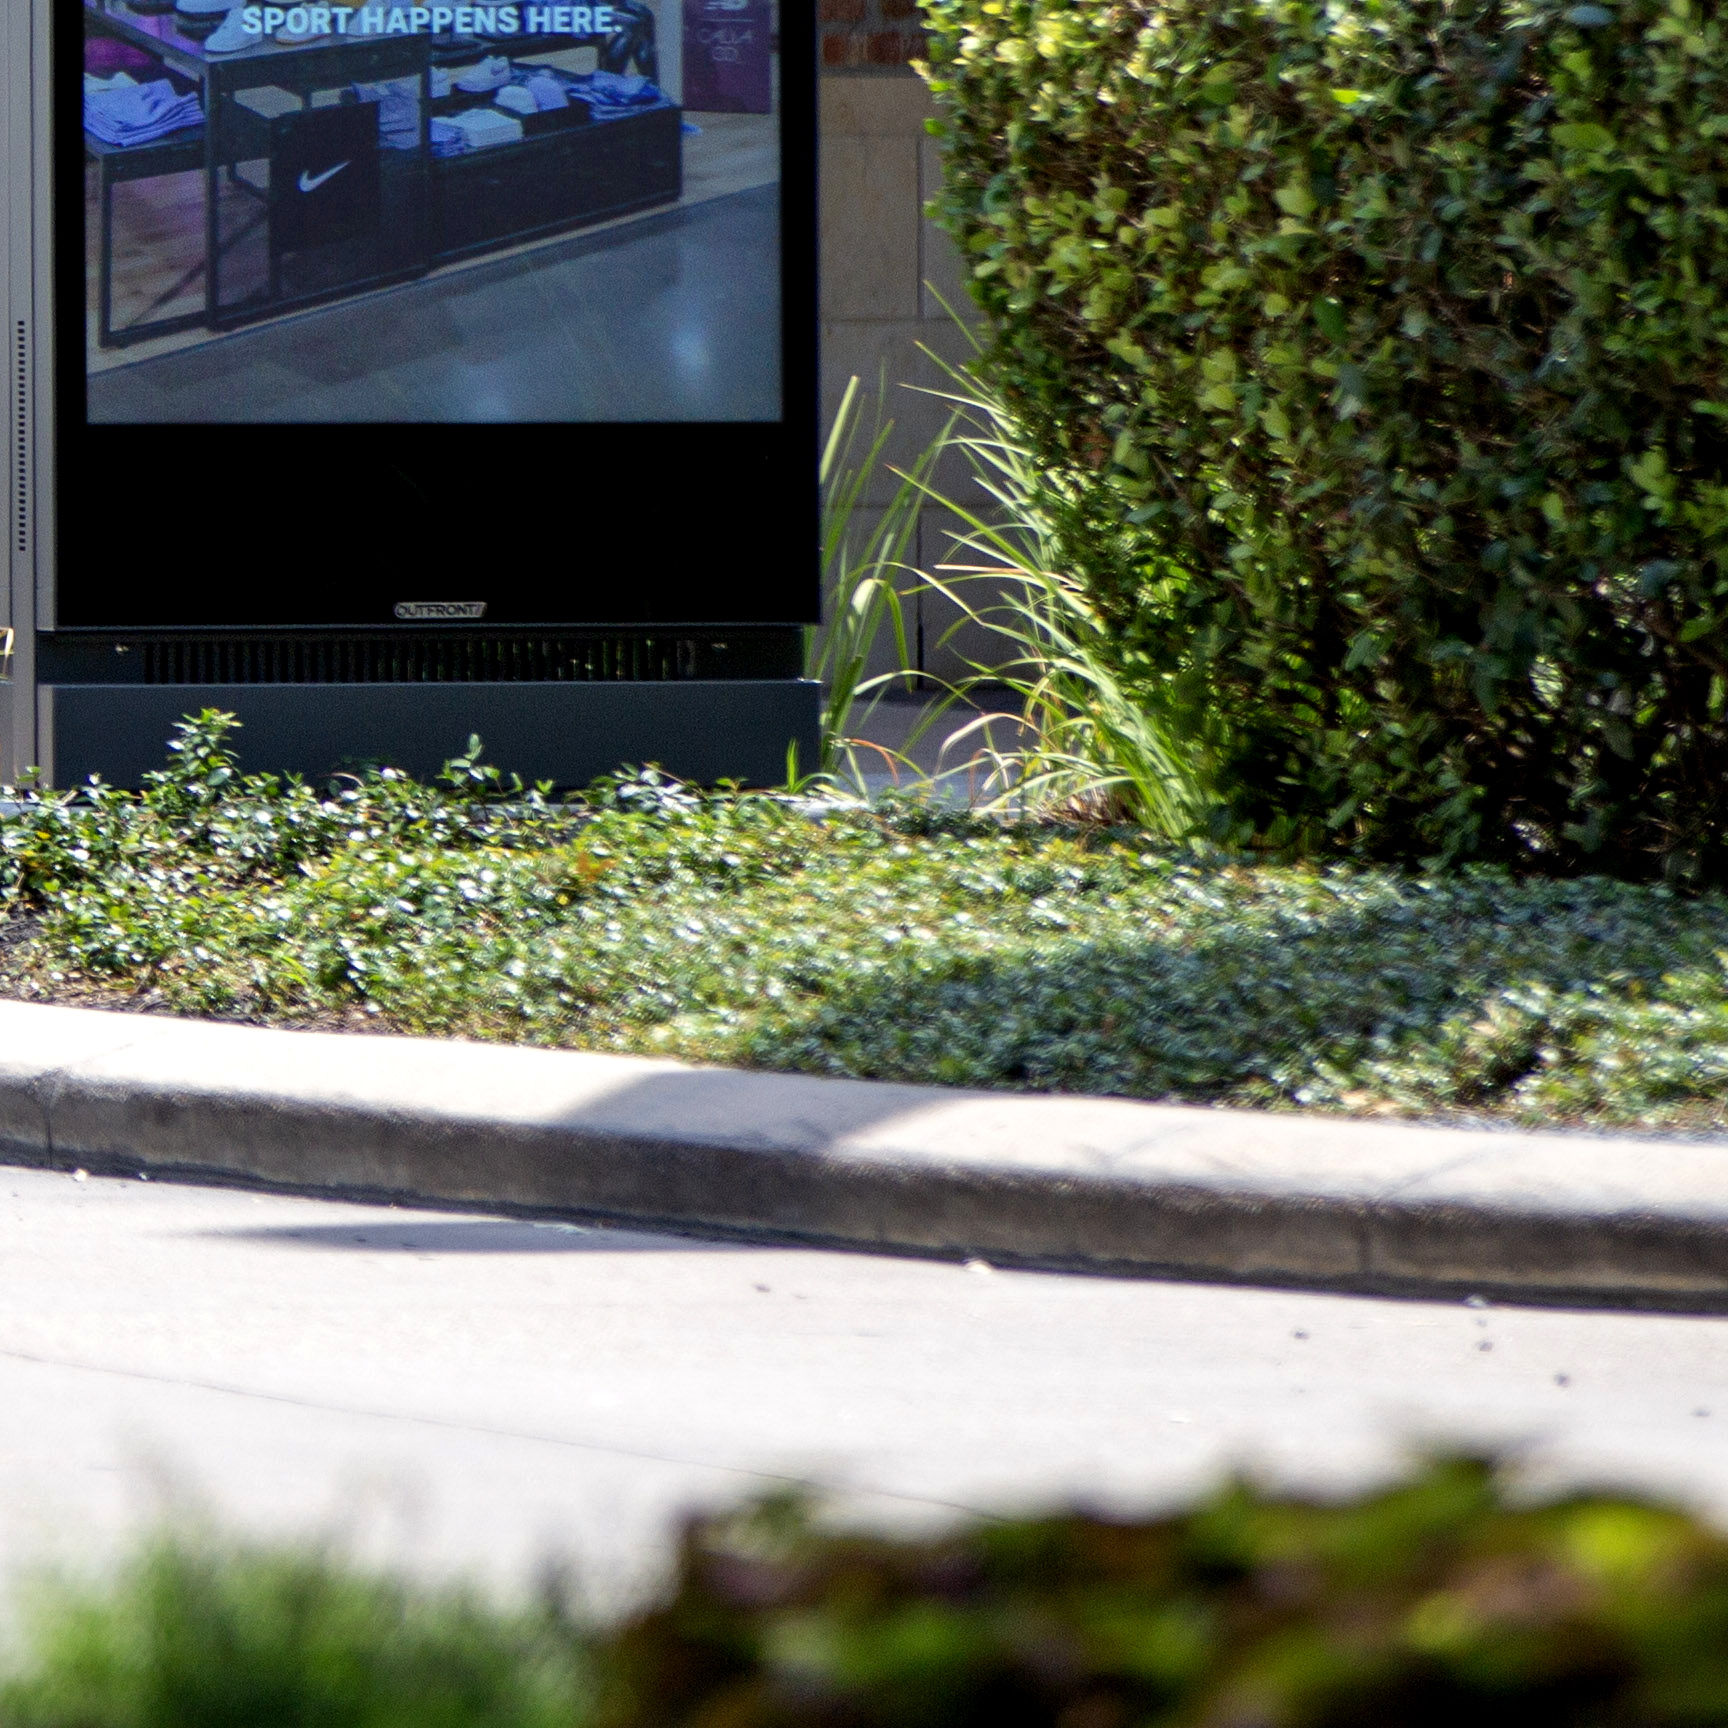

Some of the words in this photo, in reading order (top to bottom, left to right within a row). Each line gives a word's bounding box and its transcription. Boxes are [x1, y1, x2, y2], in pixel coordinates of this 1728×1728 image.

[242, 6, 355, 35] SPORT
[361, 6, 520, 35] HAPPENS
[528, 5, 623, 34] HERE.
